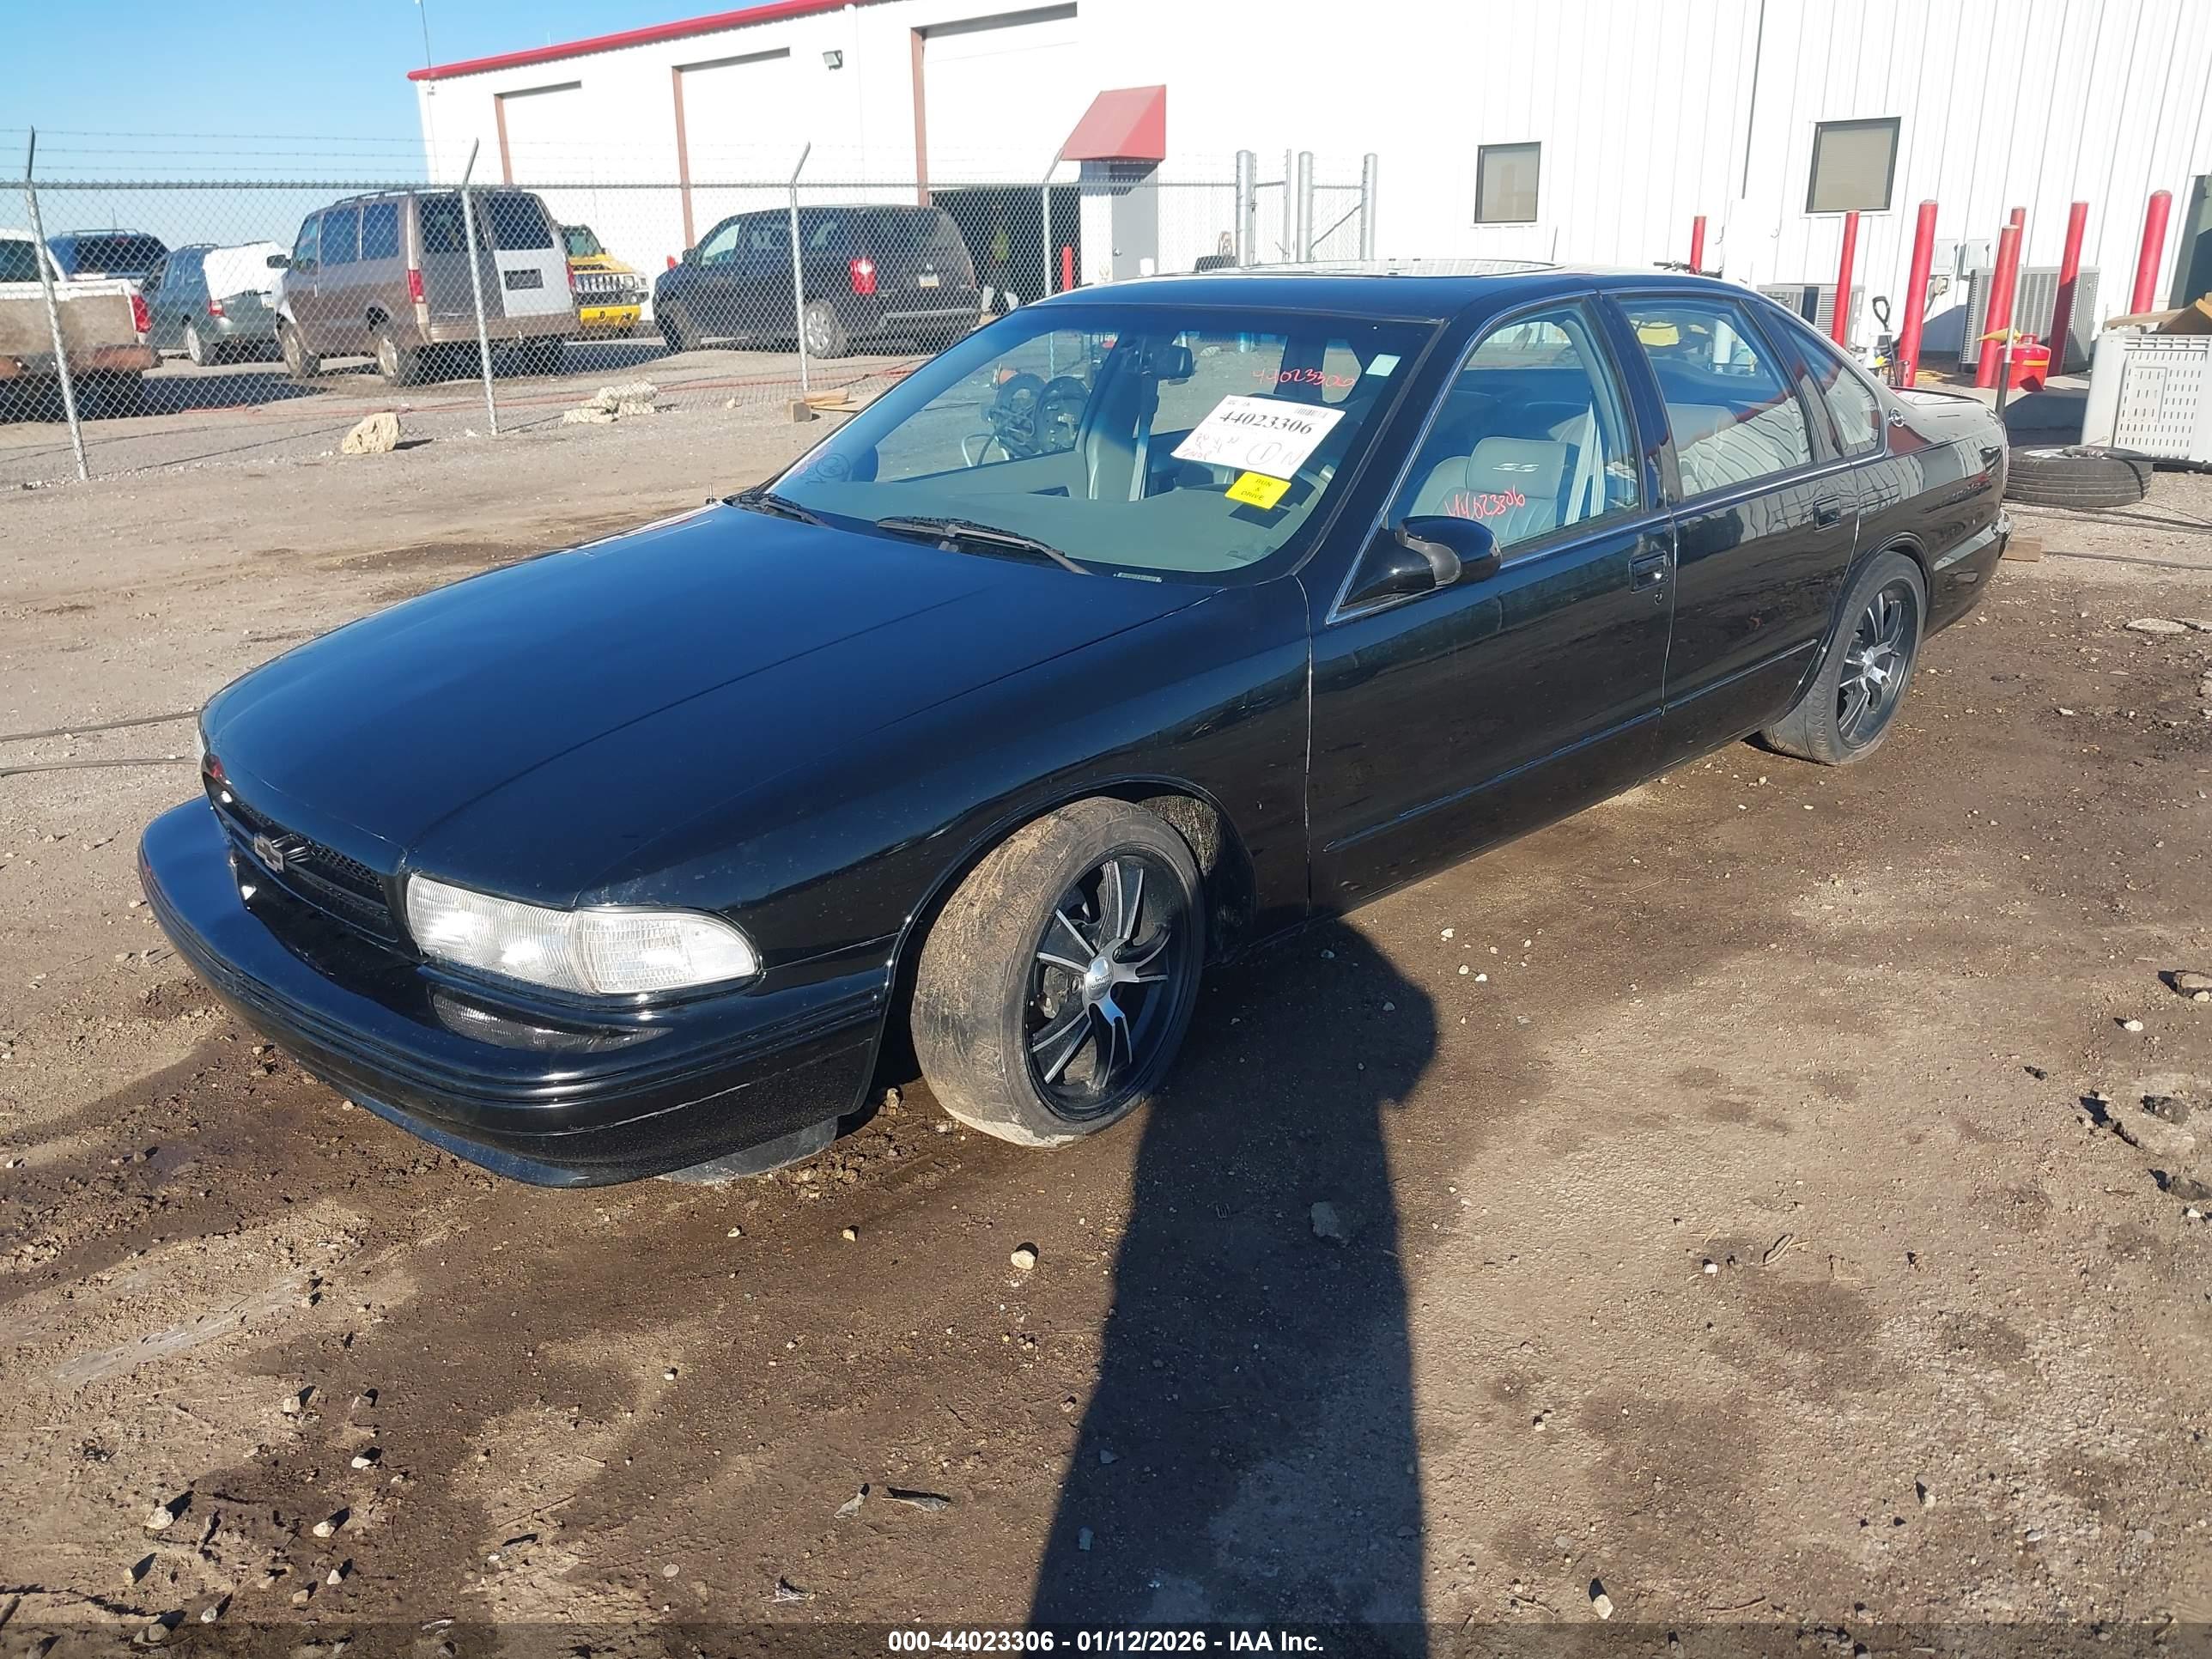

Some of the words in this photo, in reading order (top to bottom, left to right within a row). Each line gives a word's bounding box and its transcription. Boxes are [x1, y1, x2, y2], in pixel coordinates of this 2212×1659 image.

[1219, 410, 1315, 434] 44023306
[1255, 477, 1273, 487] RUN
[1241, 490, 1265, 501] DRIVE
